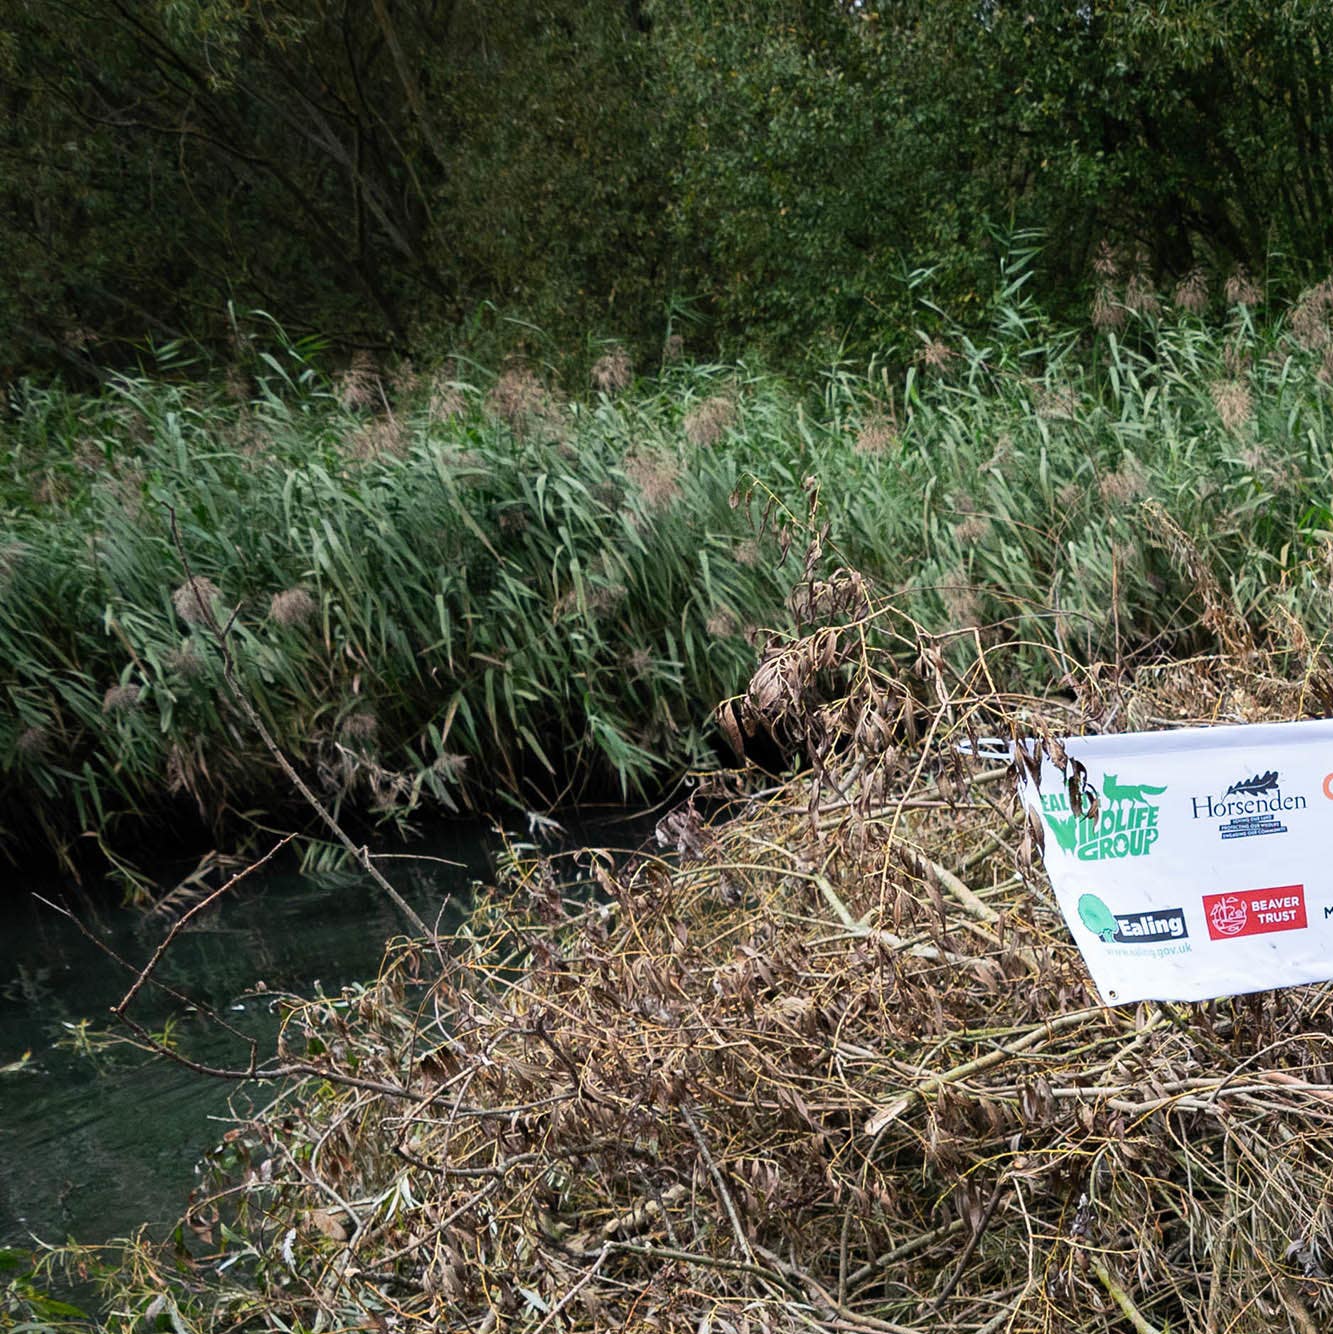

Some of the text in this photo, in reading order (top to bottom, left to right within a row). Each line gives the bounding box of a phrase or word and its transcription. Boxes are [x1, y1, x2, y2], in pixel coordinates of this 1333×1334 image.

[1191, 789, 1307, 819] Horsenden
[1077, 828, 1159, 861] GROUP
[1251, 896, 1300, 912] BEAVER
[1117, 916, 1184, 937] Ealing
[1257, 909, 1297, 924] TRUST
